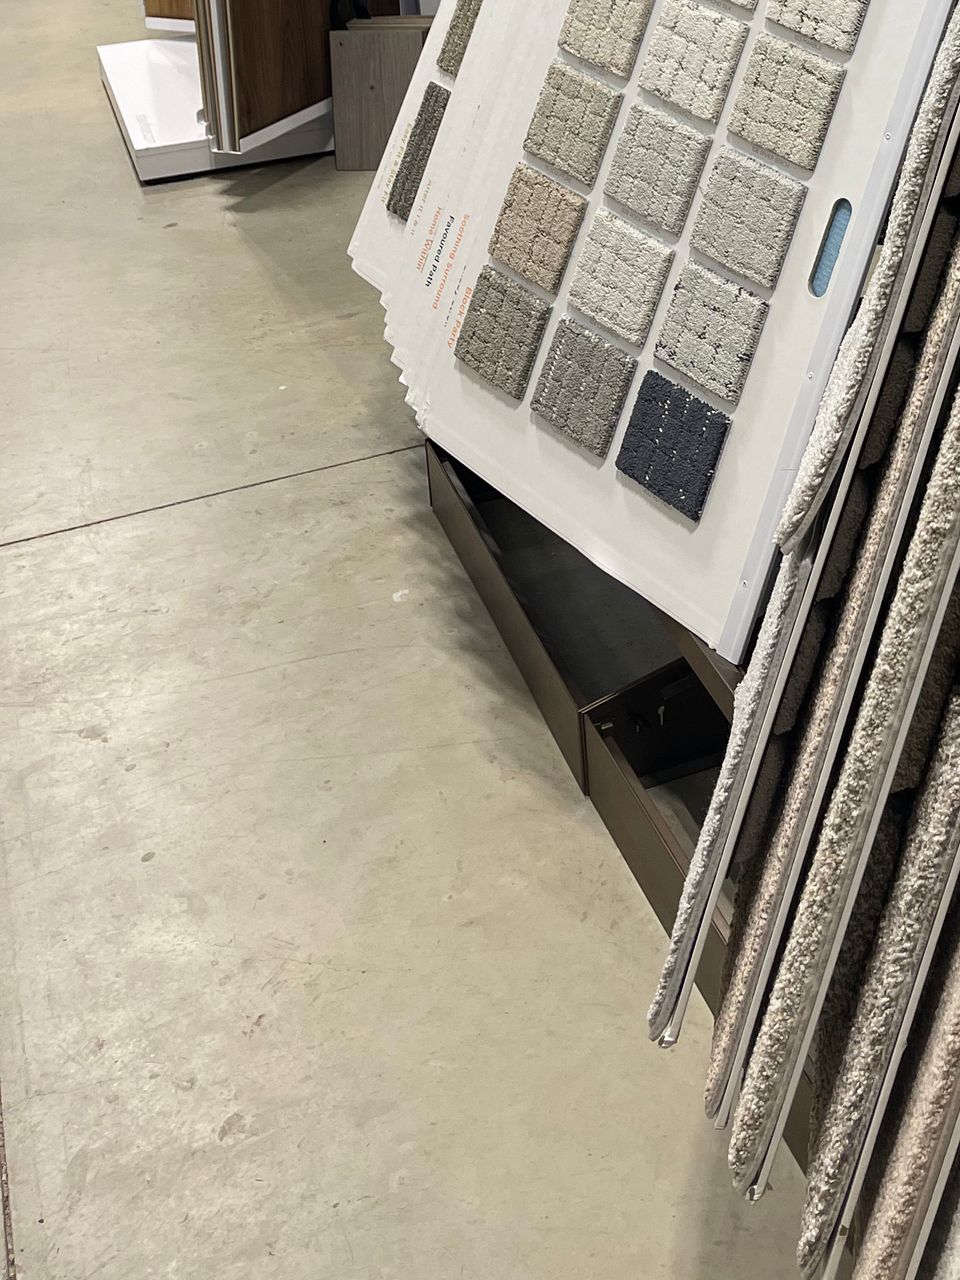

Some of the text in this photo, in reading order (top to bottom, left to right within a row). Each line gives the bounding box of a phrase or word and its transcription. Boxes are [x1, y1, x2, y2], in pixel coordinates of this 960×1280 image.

[429, 207, 442, 235] Home
[449, 213, 470, 260] Soothing
[416, 238, 433, 271] Within
[435, 215, 455, 262] Favoured
[425, 262, 437, 287] Path
[432, 262, 453, 309] Surround
[459, 287, 473, 317] Block
[447, 317, 463, 349] Party
